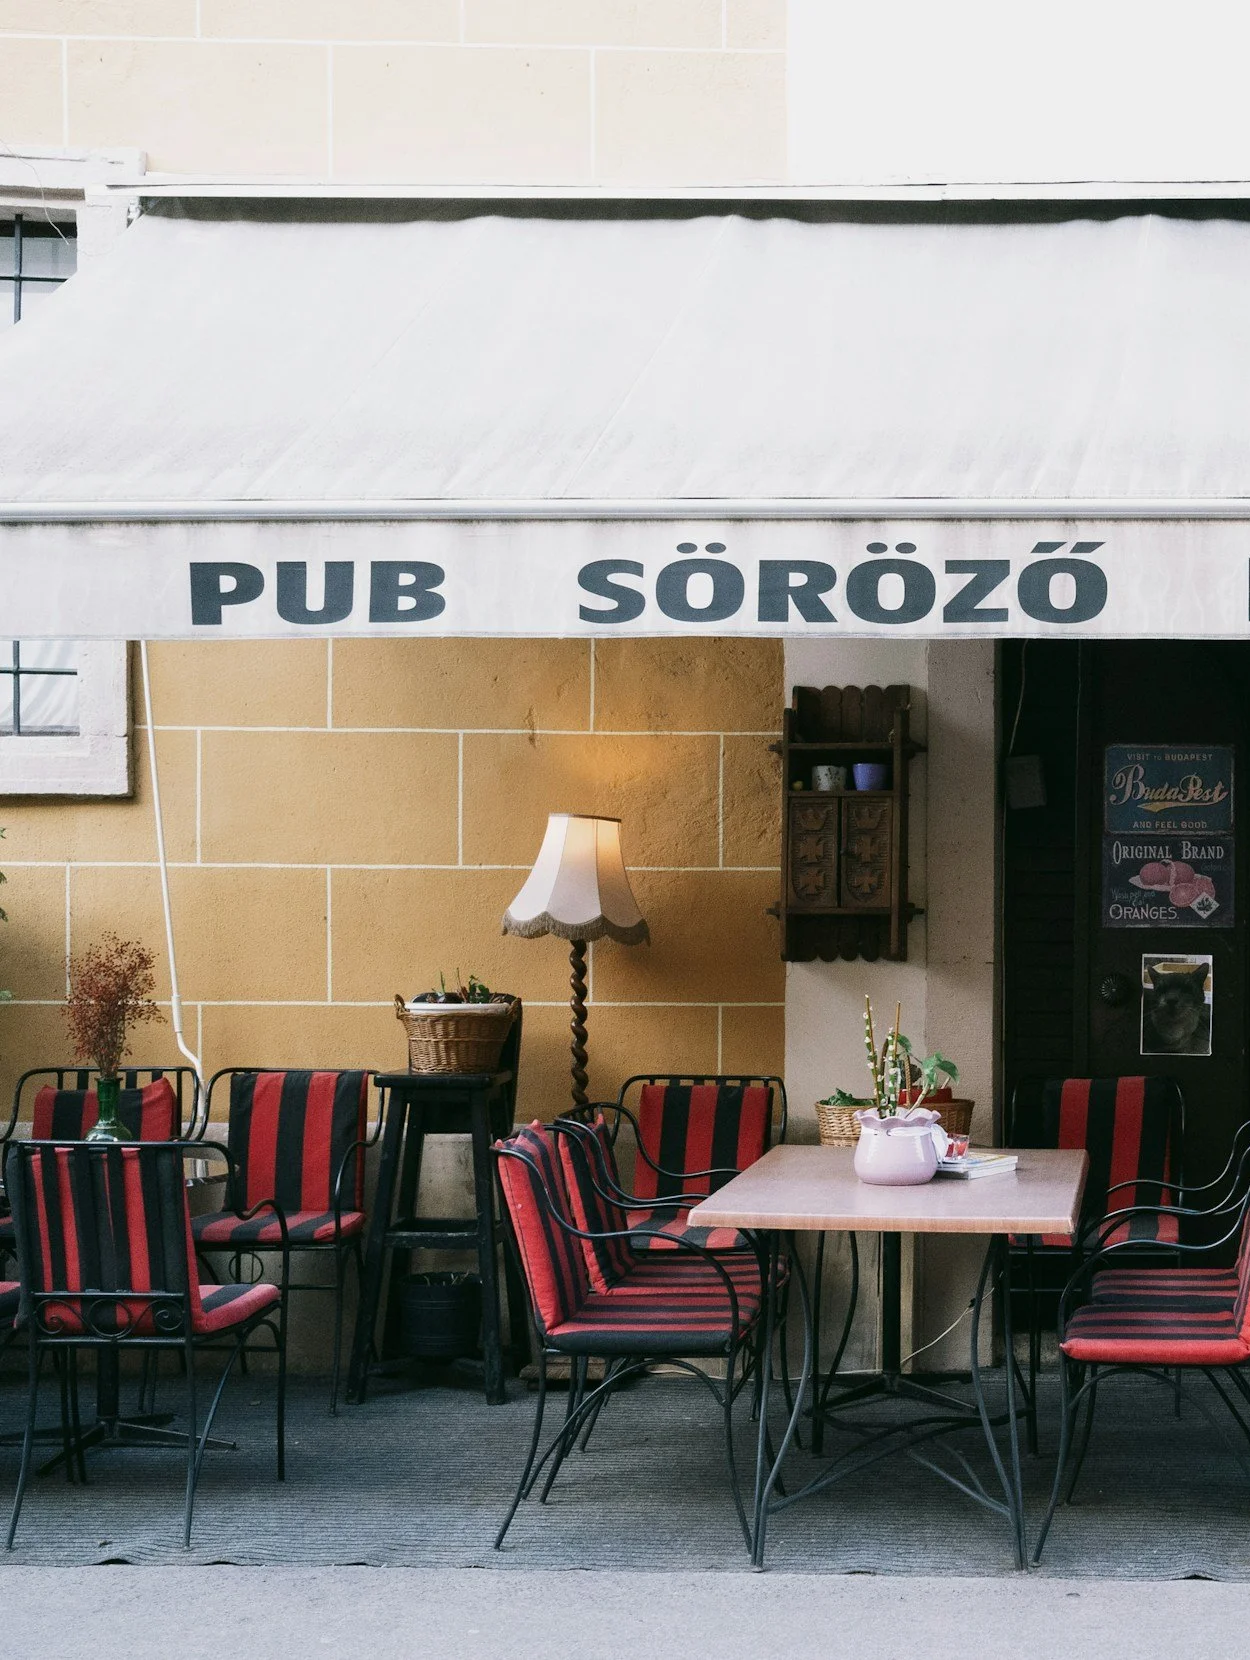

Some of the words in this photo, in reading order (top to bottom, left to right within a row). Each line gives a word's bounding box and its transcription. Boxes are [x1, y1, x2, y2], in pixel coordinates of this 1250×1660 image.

[189, 560, 446, 626] PUB
[577, 541, 1108, 625] SÖRÖZŐ
[1127, 753, 1150, 761] VISIT
[1164, 753, 1213, 761] BUDAPEST
[1132, 821, 1152, 829] AND
[1155, 821, 1177, 829] FEEL
[1180, 821, 1208, 829] GOOD
[1112, 840, 1172, 864] ORIGINAL
[1181, 840, 1224, 859] BRAND
